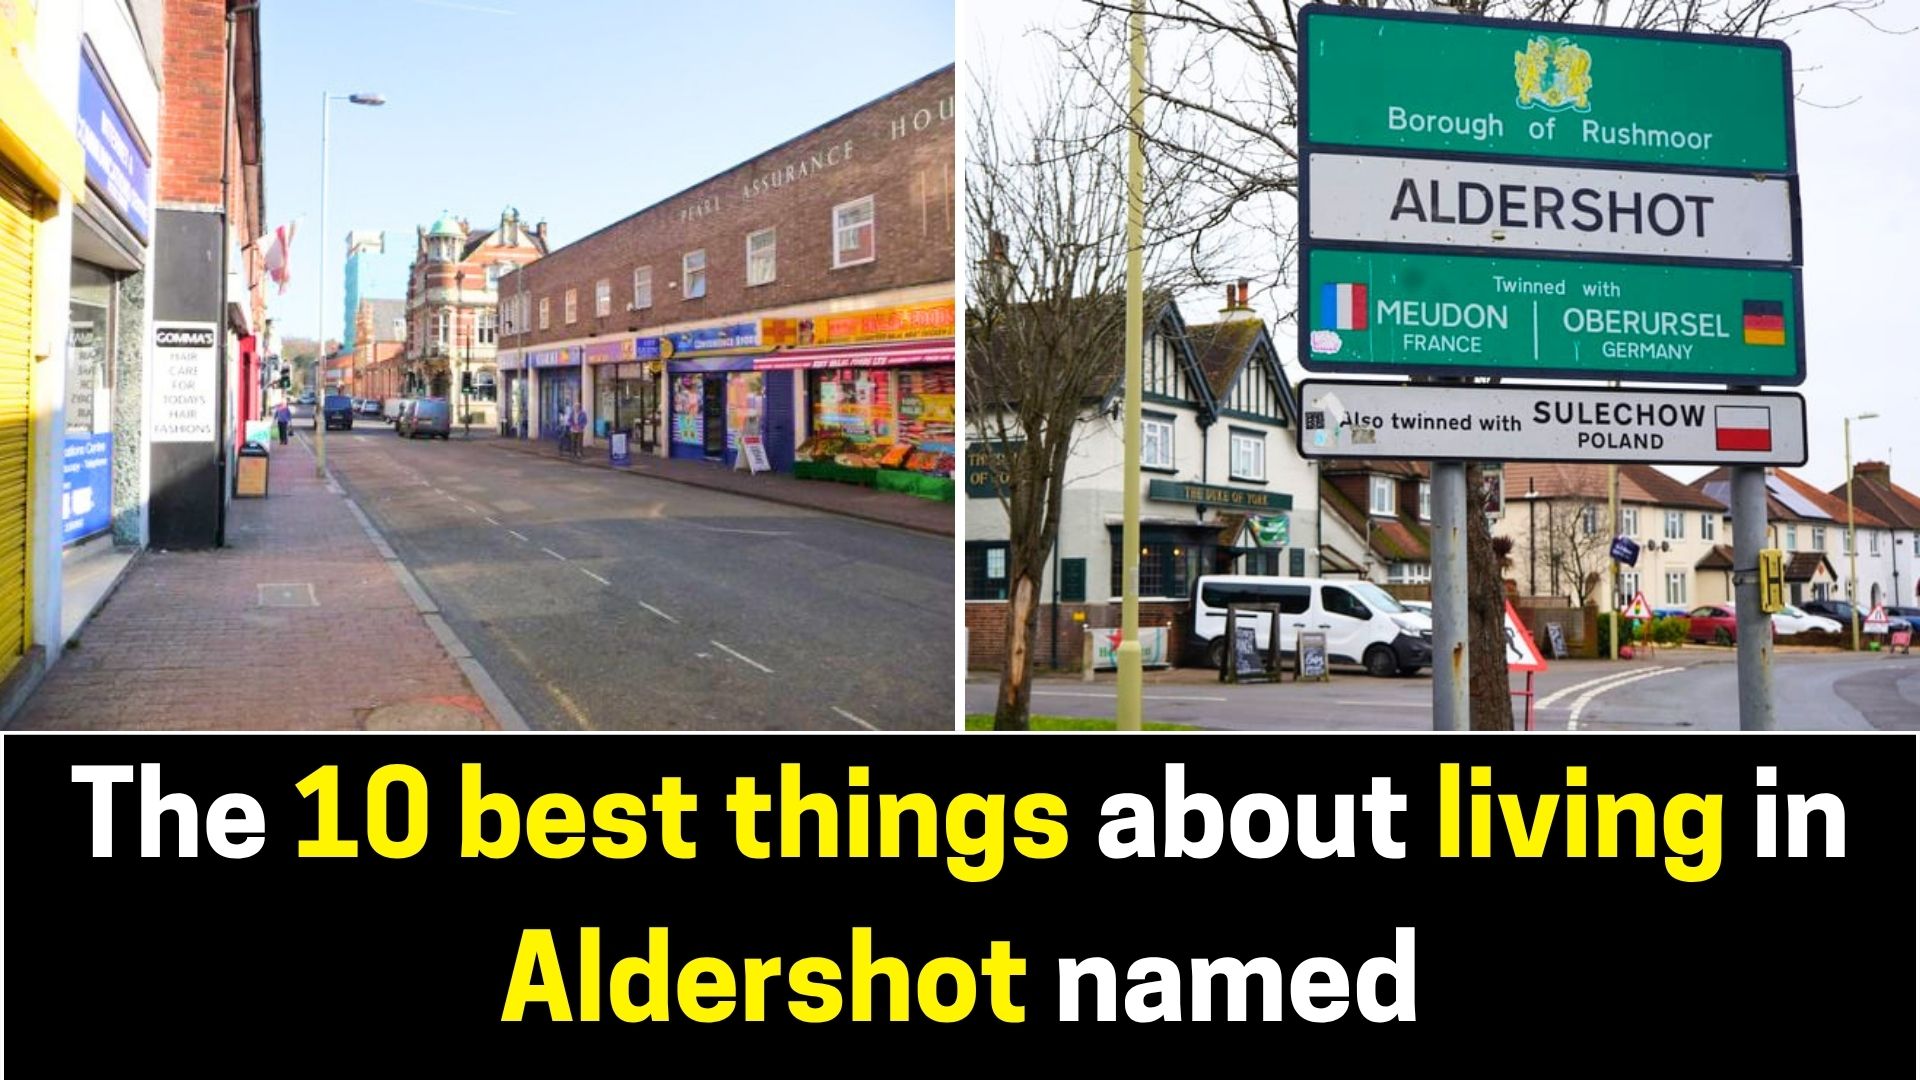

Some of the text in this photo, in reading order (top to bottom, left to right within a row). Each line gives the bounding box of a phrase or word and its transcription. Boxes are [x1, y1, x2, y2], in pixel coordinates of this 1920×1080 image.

[1388, 106, 1713, 151] Borough of Rushmoor
[740, 139, 855, 201] ASSURANCE
[1390, 178, 1715, 238] ALDERSHOT
[1493, 276, 1621, 298] Twinned with
[1377, 300, 1509, 329] MEUDON
[1563, 308, 1730, 339] OBERURSEL
[1403, 334, 1482, 353] FRANCE
[1602, 340, 1694, 361] GERMANY
[169, 351, 199, 361] HAIR
[168, 365, 200, 376] CARE
[171, 379, 196, 390] FOR
[168, 408, 198, 419] HAIR
[1339, 411, 1522, 432] Also twinned with
[1532, 400, 1707, 427] SULECHOW
[1578, 431, 1664, 450] POLAND
[1185, 486, 1268, 505] THE DUKE OF YORK
